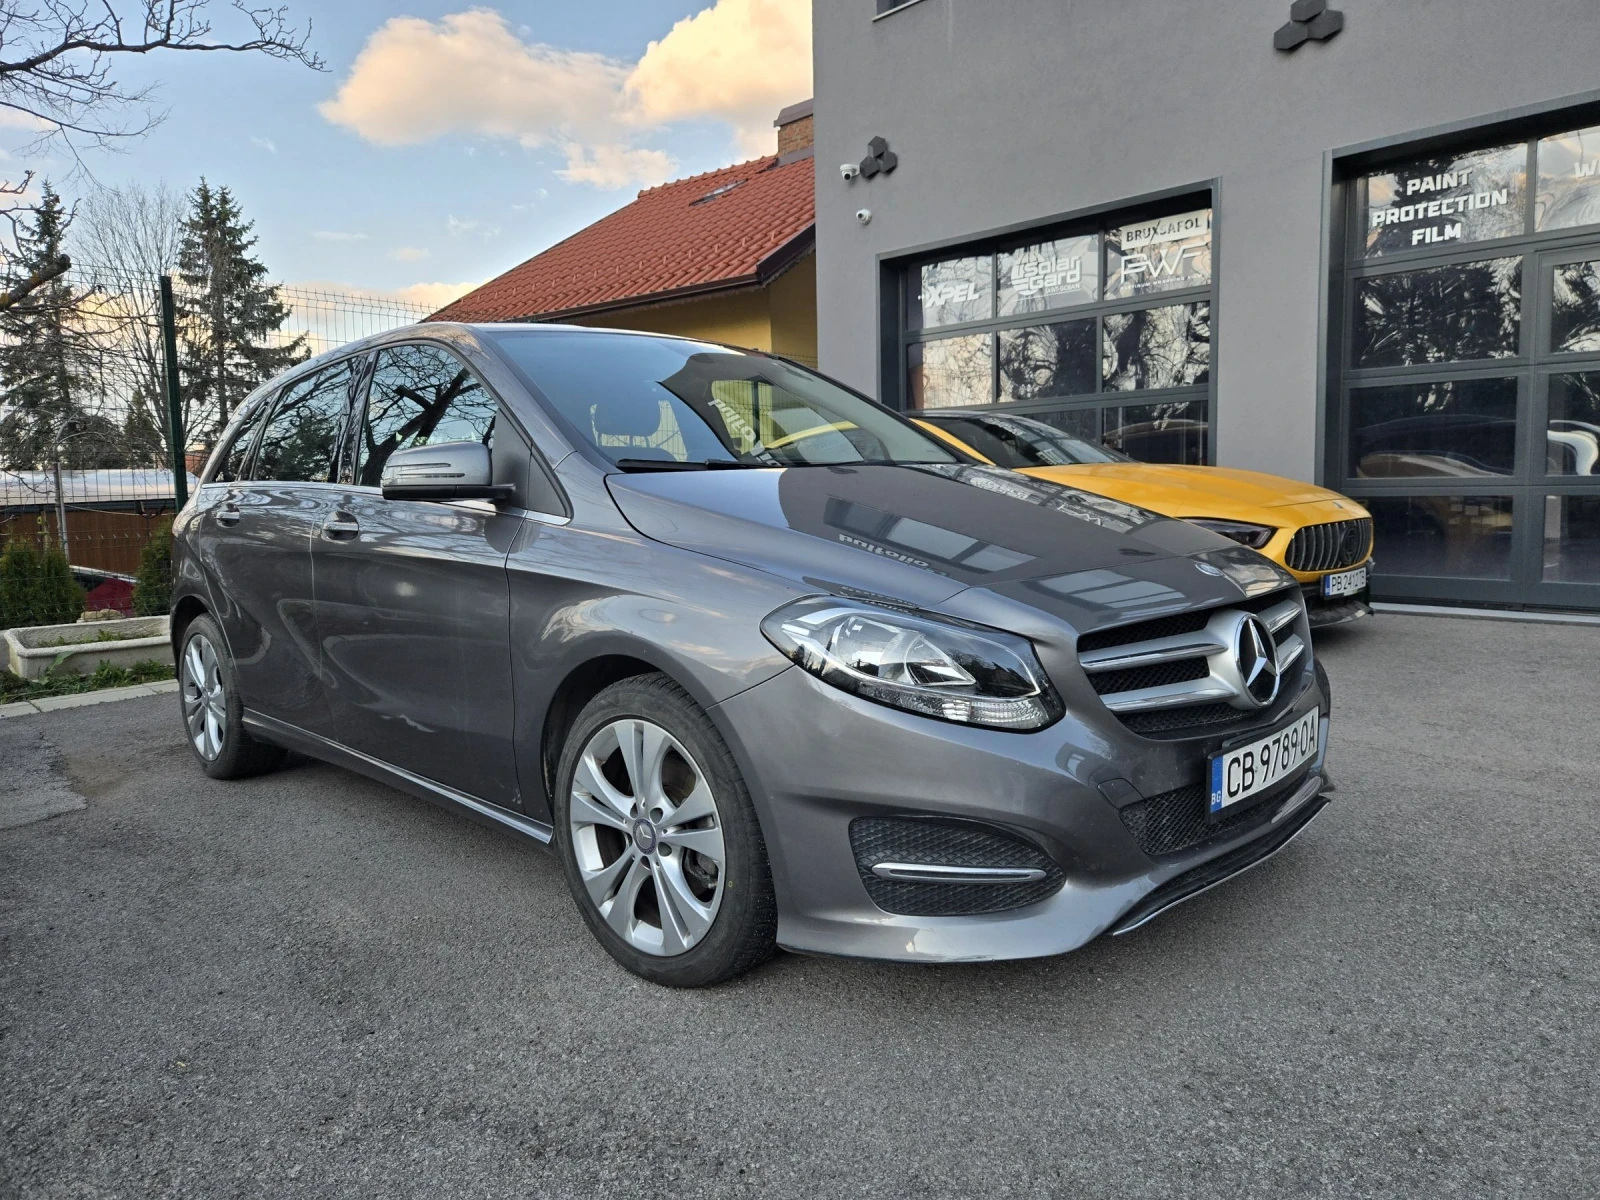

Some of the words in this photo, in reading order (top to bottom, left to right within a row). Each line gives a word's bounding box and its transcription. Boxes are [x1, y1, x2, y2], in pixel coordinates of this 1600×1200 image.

[1574, 158, 1600, 178] W
[1407, 167, 1473, 195] PAINT
[1372, 188, 1508, 227] PROTECTION
[1126, 217, 1202, 242] BRUXSAFOL
[1412, 222, 1462, 246] FILM
[925, 282, 980, 308] XPEL
[1332, 576, 1342, 593] PB
[1227, 751, 1255, 798] CB
[1260, 727, 1298, 783] 9789
[1300, 715, 1315, 757] OA
[1211, 790, 1221, 805] BG
